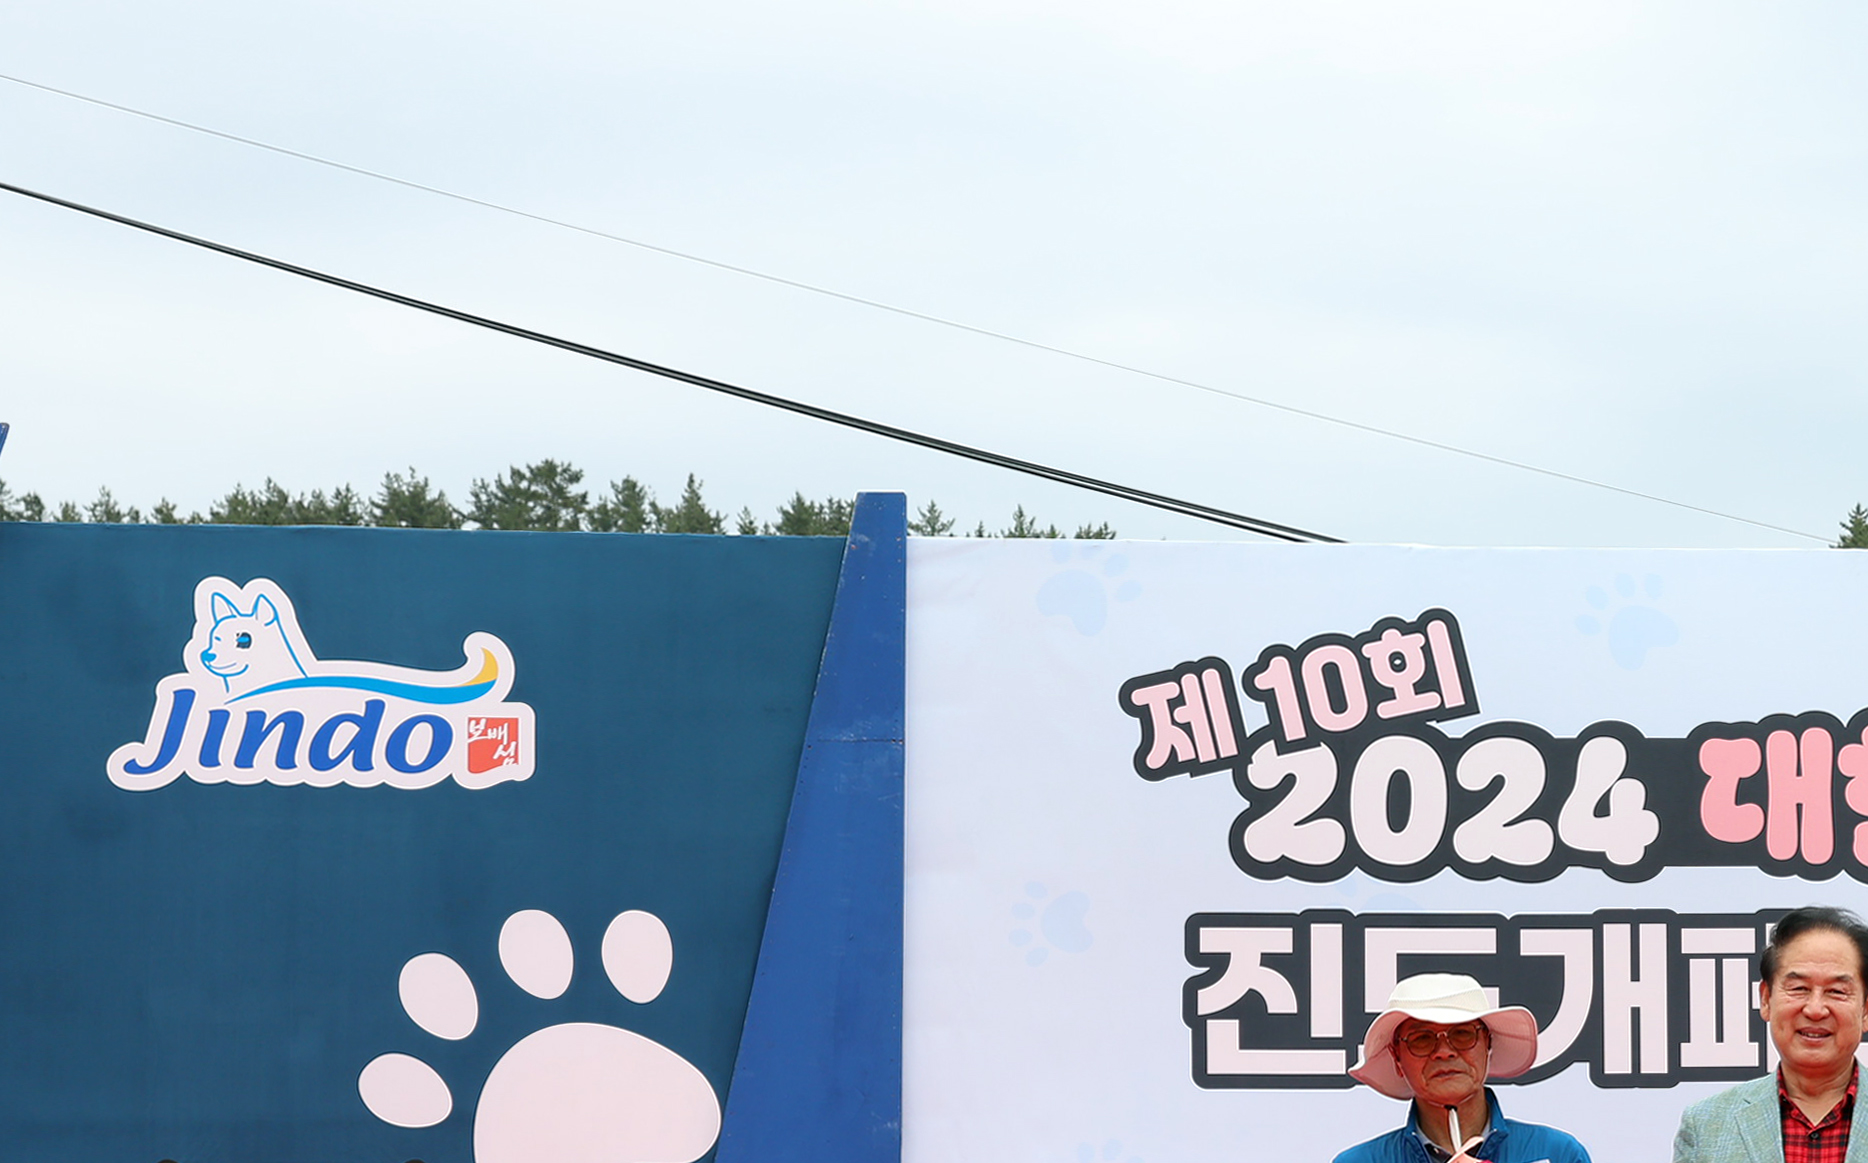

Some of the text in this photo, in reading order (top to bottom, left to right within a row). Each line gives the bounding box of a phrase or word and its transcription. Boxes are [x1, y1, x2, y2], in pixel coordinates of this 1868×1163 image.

[123, 688, 454, 775] Jindo
[1131, 618, 1467, 771] 제 10회
[1243, 735, 1661, 867] 2024
